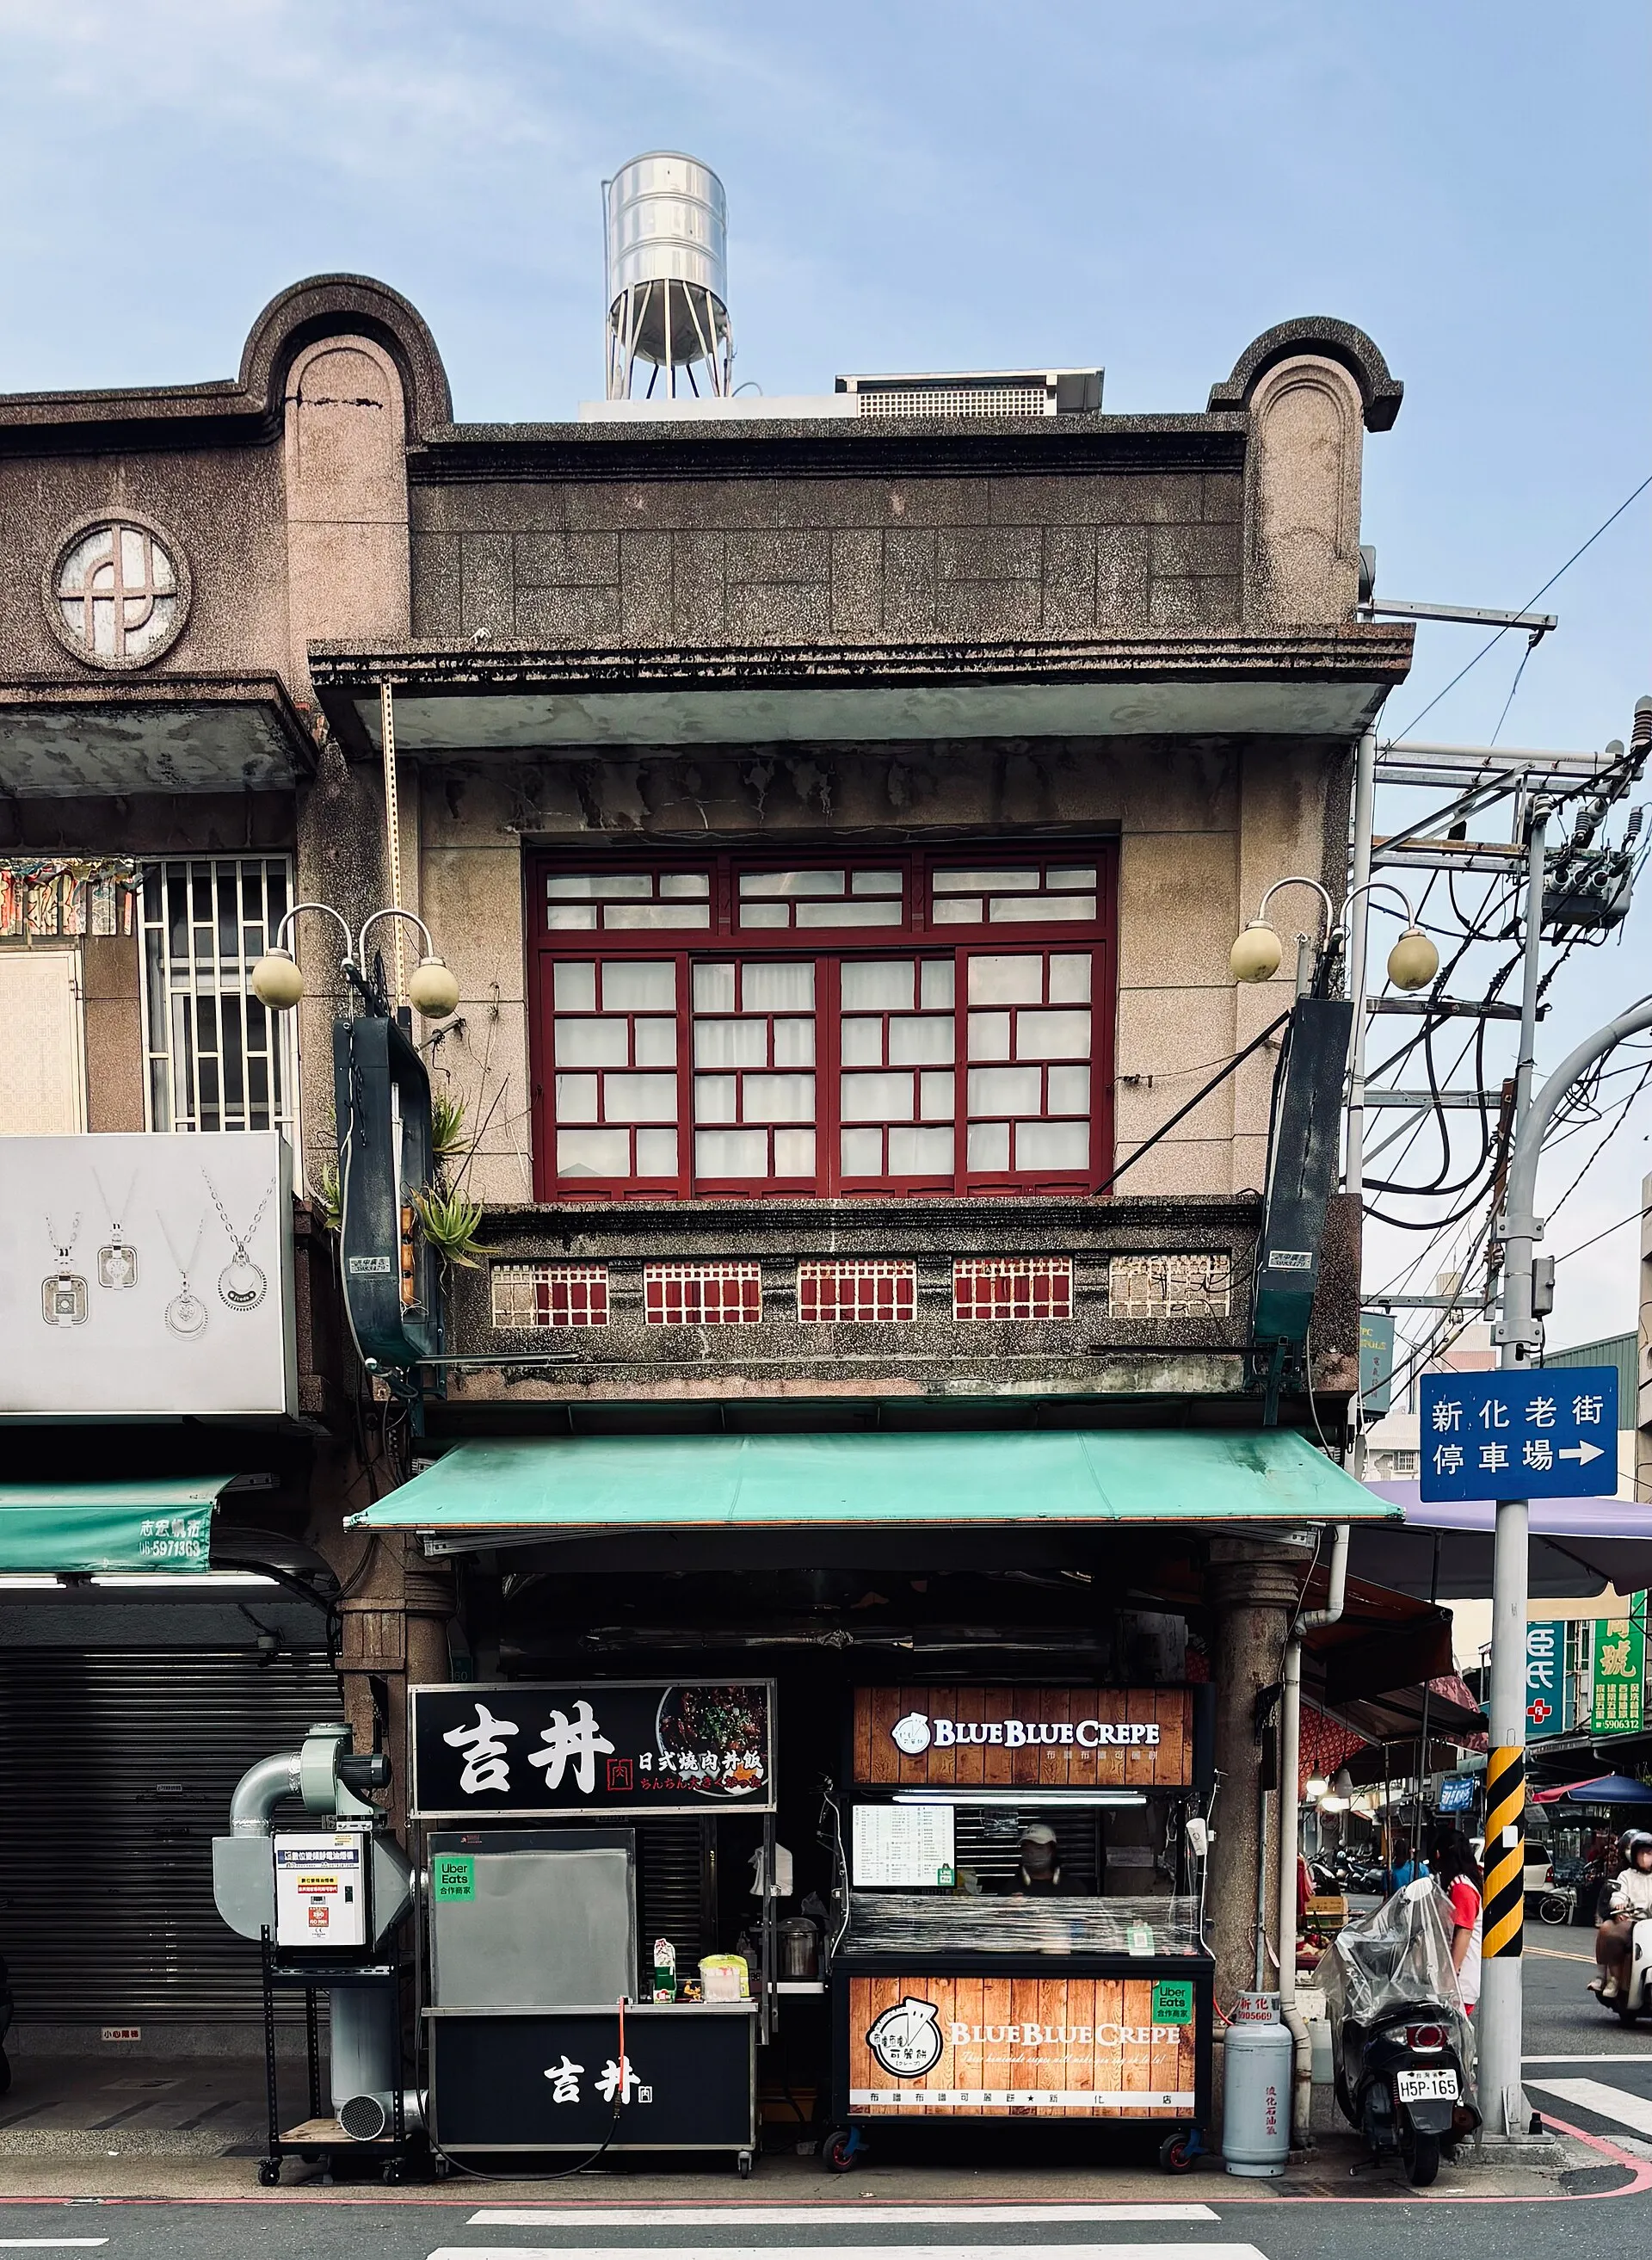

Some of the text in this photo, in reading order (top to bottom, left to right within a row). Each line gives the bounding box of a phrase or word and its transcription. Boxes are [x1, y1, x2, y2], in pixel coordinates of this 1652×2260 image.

[1432, 1395, 1604, 1432] 新化老街
[1432, 1439, 1554, 1475] 停車場
[1526, 1621, 1555, 1689] 臣氏
[443, 1700, 615, 1794] 吉井
[441, 1863, 467, 1873] Uber
[441, 1874, 468, 1884] Eats
[440, 1886, 471, 1895] 合作商家
[1160, 1986, 1186, 1997] Uber
[1160, 1998, 1186, 2007] Eats
